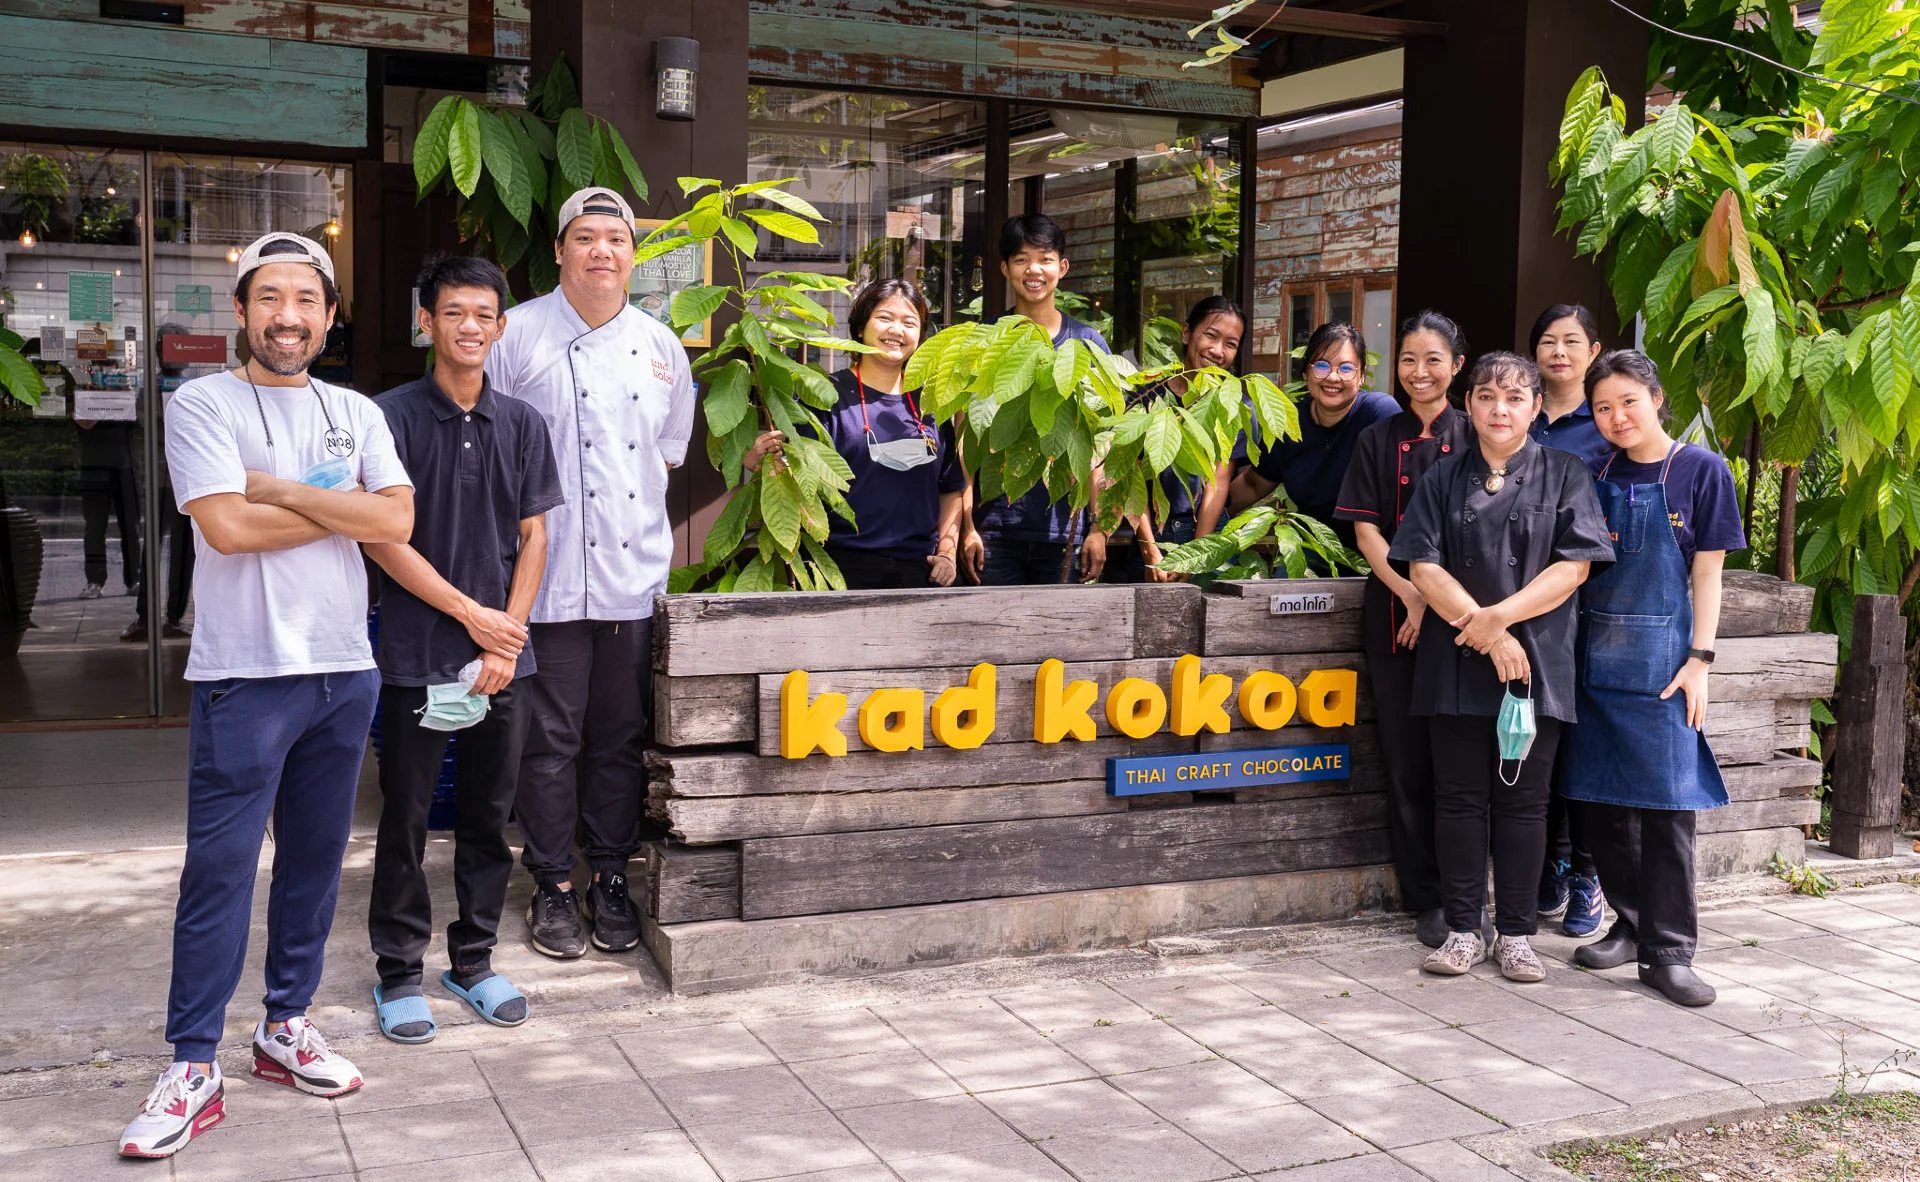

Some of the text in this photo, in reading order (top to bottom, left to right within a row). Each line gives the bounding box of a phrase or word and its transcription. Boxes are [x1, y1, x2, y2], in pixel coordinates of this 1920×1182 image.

[662, 254, 692, 263] VANILLA
[660, 262, 691, 270] MOSTLY
[643, 268, 691, 279] THAI LOVE
[780, 653, 1357, 759] kad kokoa
[1125, 755, 1342, 785] THAI CRAFT CHOCOLATE
